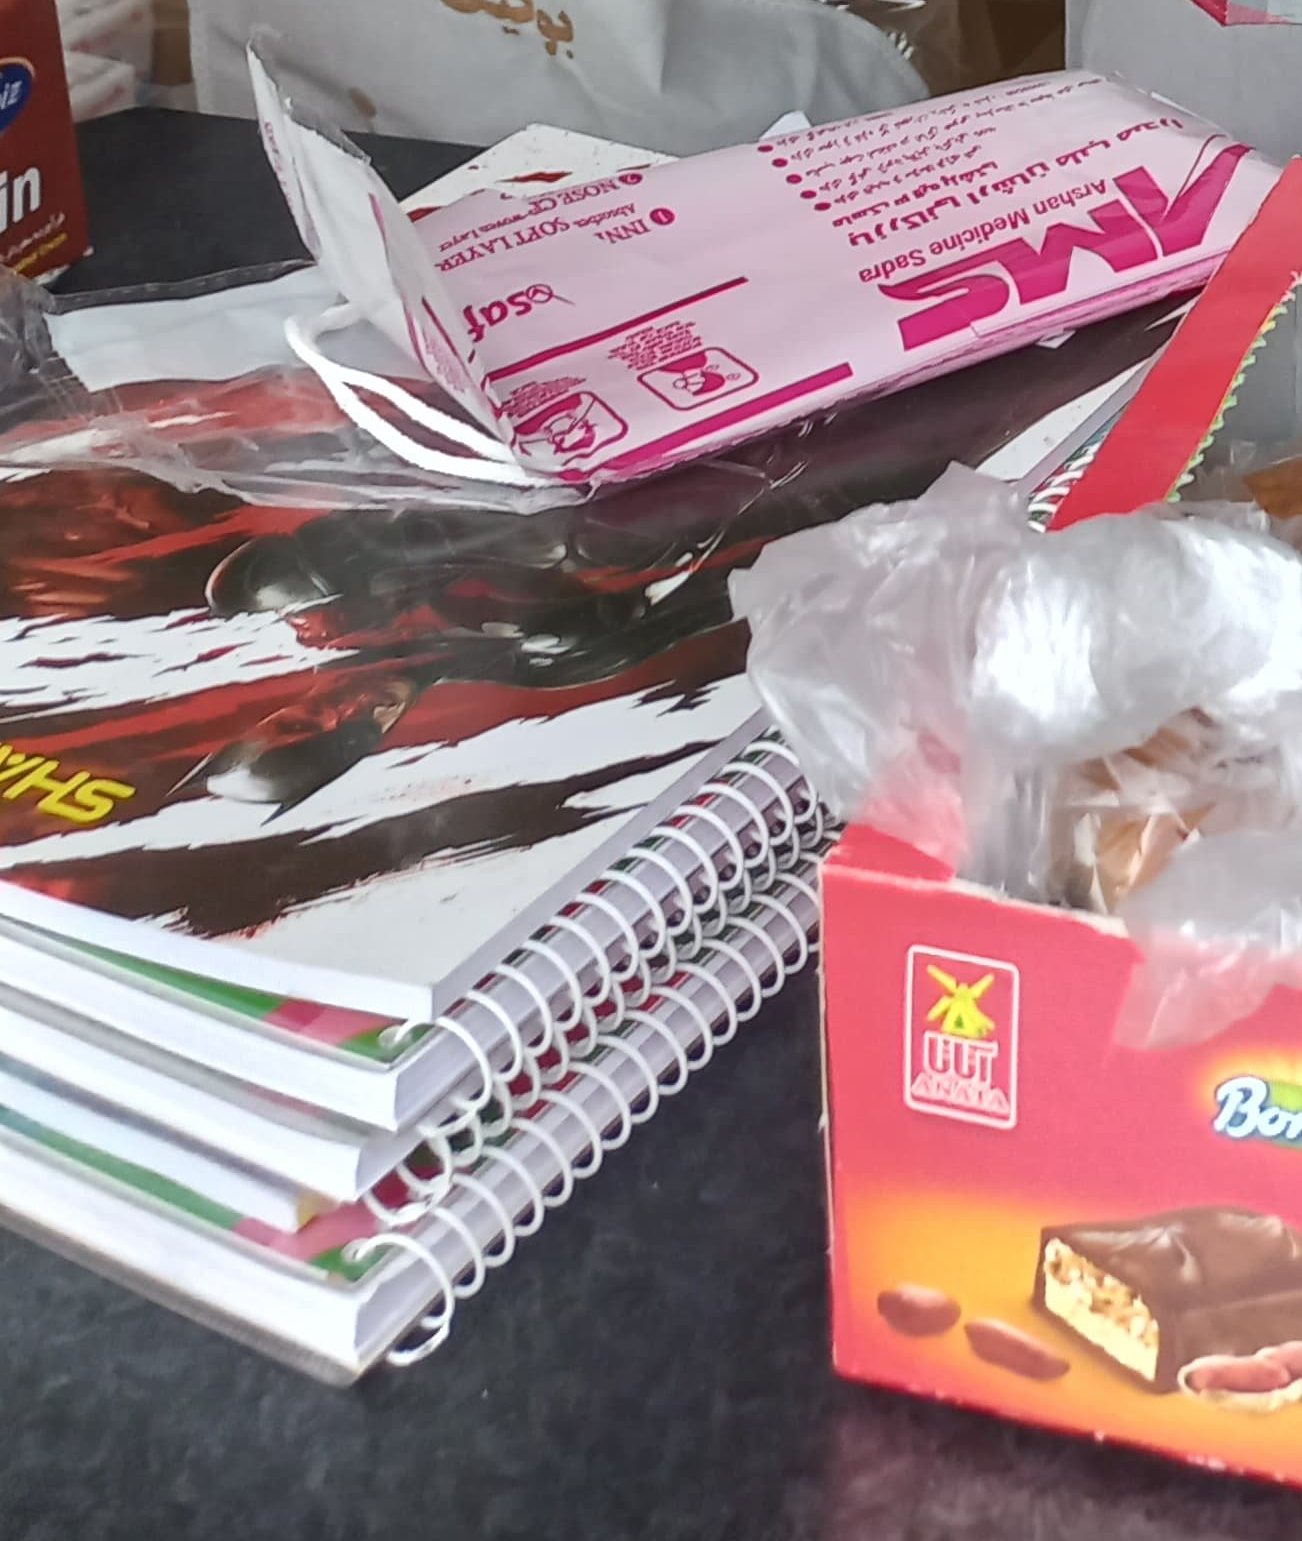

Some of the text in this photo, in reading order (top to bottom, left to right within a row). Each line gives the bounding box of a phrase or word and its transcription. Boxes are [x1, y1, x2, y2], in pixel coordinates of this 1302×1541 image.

[556, 179, 620, 207] NOSE
[832, 201, 890, 228] ماسک
[848, 195, 962, 248] بازرگانی
[966, 160, 1051, 205] ارشان
[433, 216, 572, 273] SOFT LAYER
[858, 178, 1109, 284] Arshan Medicine Sadra
[878, 141, 1253, 351] AMS
